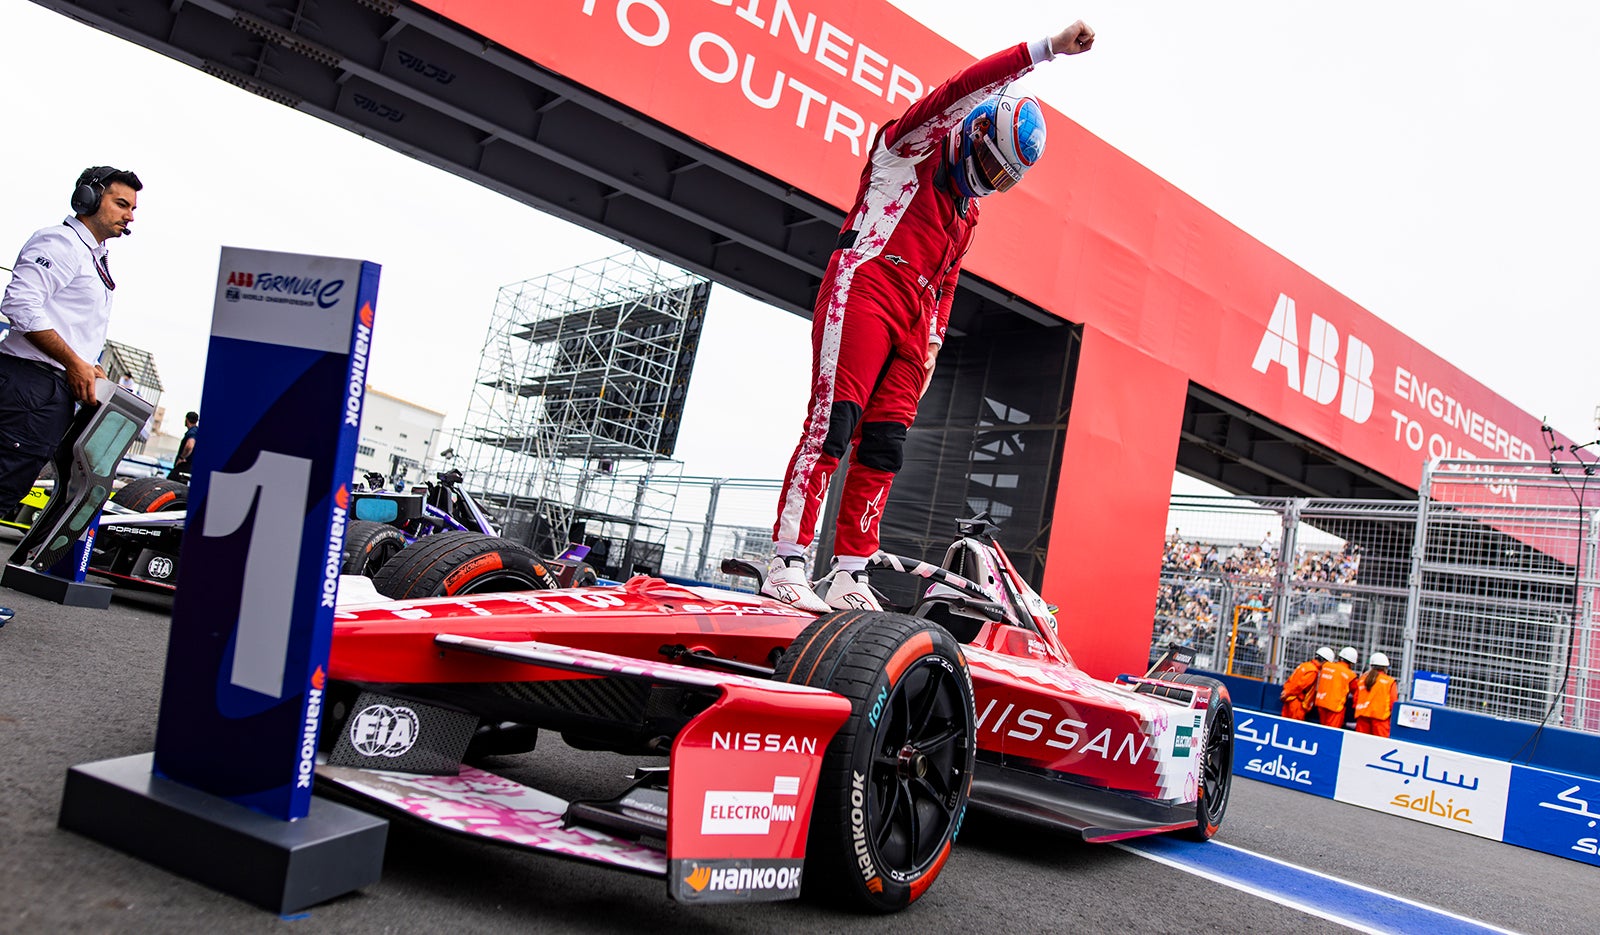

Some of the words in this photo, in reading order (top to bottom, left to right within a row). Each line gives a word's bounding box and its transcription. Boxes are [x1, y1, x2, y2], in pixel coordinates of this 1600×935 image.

[227, 271, 254, 287] ABB
[253, 273, 318, 298] FORMULA
[1252, 292, 1374, 424] ABB
[1391, 410, 1424, 451] TO
[1394, 366, 1535, 470] ENGINEERED
[107, 525, 161, 537] PORSCHE
[202, 449, 313, 699] 1
[711, 731, 818, 755] NISSAN
[1244, 754, 1313, 786] sabic
[710, 804, 797, 822] ELECTROMIN
[1390, 790, 1473, 825] sabic
